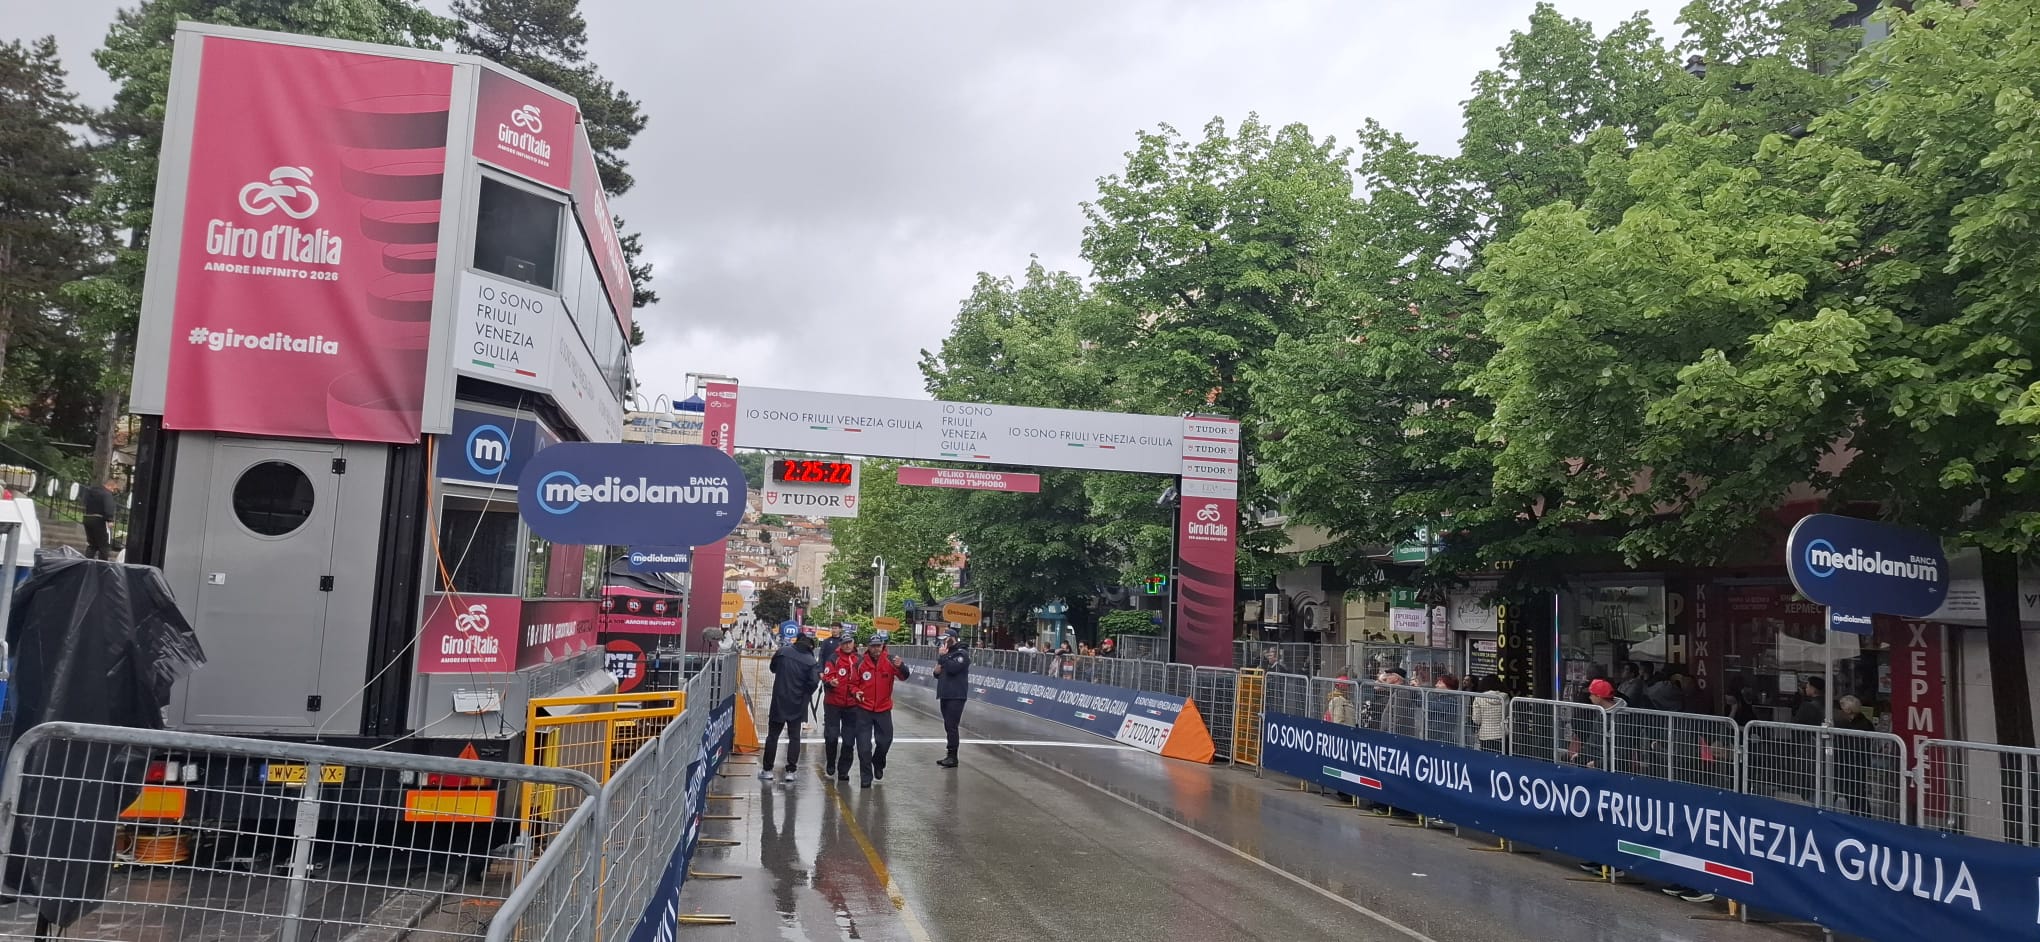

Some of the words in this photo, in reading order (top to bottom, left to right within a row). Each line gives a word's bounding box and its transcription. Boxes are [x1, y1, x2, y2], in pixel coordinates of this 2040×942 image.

[498, 123, 519, 147] Giro
[519, 134, 550, 159] d'Italia
[206, 218, 258, 258] Giro
[261, 224, 342, 265] d'Italia
[204, 262, 250, 274] AMORE
[252, 266, 308, 279] INFINITO
[310, 270, 338, 281] 2026
[479, 285, 495, 301] IO
[500, 291, 543, 314] SONO
[477, 304, 517, 326] FRIULI
[188, 327, 339, 355] #giroditalia
[476, 322, 534, 349] VENEZIA
[473, 341, 520, 364] GIULIA
[746, 409, 760, 418] IO
[763, 410, 798, 422] SONO
[802, 413, 834, 424] FRIULI
[837, 416, 884, 428] VENEZIA
[887, 418, 923, 430] GIULIA
[942, 404, 954, 414] IO
[958, 406, 992, 416] SONO
[942, 416, 972, 427] FRIULI
[1196, 425, 1228, 434] TUDOR
[942, 429, 988, 440] VENEZIA
[1009, 427, 1021, 436] IO
[1024, 428, 1057, 439] SONO
[1060, 430, 1090, 442] FRIULI
[1092, 432, 1136, 445] VENEZIA
[1139, 436, 1173, 447] GIULIA
[940, 441, 976, 451] GIULIA
[1195, 446, 1227, 454] TUDOR
[784, 460, 852, 484] 2:25:22
[938, 470, 964, 479] VELIKO
[966, 472, 1002, 481] TARNOVO
[1194, 466, 1226, 474] TUDOR
[546, 477, 728, 504] mediolanum
[690, 477, 728, 486] BANCA
[932, 477, 966, 486] (ВЕЛИКО
[967, 480, 1006, 489] ТЪРНОВО)
[782, 494, 840, 506] TUDOR
[1188, 522, 1204, 534] Giro
[1204, 523, 1228, 536] d'Italia
[634, 554, 687, 563] mediolanum
[1494, 560, 1514, 570] СТУ
[1812, 548, 1938, 582] mediolanum
[1910, 556, 1937, 566] BANCA
[1785, 604, 1822, 614] ХЕРМЕС
[1498, 602, 1506, 648] ОТО
[1833, 614, 1872, 624] mediolanum
[442, 635, 465, 654] Giro
[1062, 690, 1080, 706] SONO
[1091, 696, 1111, 712] VENEZIA
[1109, 700, 1128, 716] GIULIA
[1128, 722, 1160, 744] TUDOR
[1267, 722, 1279, 744] IO
[1280, 724, 1314, 752] SONO
[1316, 732, 1348, 762] FRIULI
[1351, 740, 1410, 778] VENEZIA
[1415, 755, 1473, 793] GIULIA
[1491, 769, 1514, 801] IO
[1520, 775, 1590, 818] SONO
[1598, 790, 1674, 837] FRIULI
[1684, 804, 1825, 873] VENEZIA
[1834, 838, 1982, 911] GIULIA
